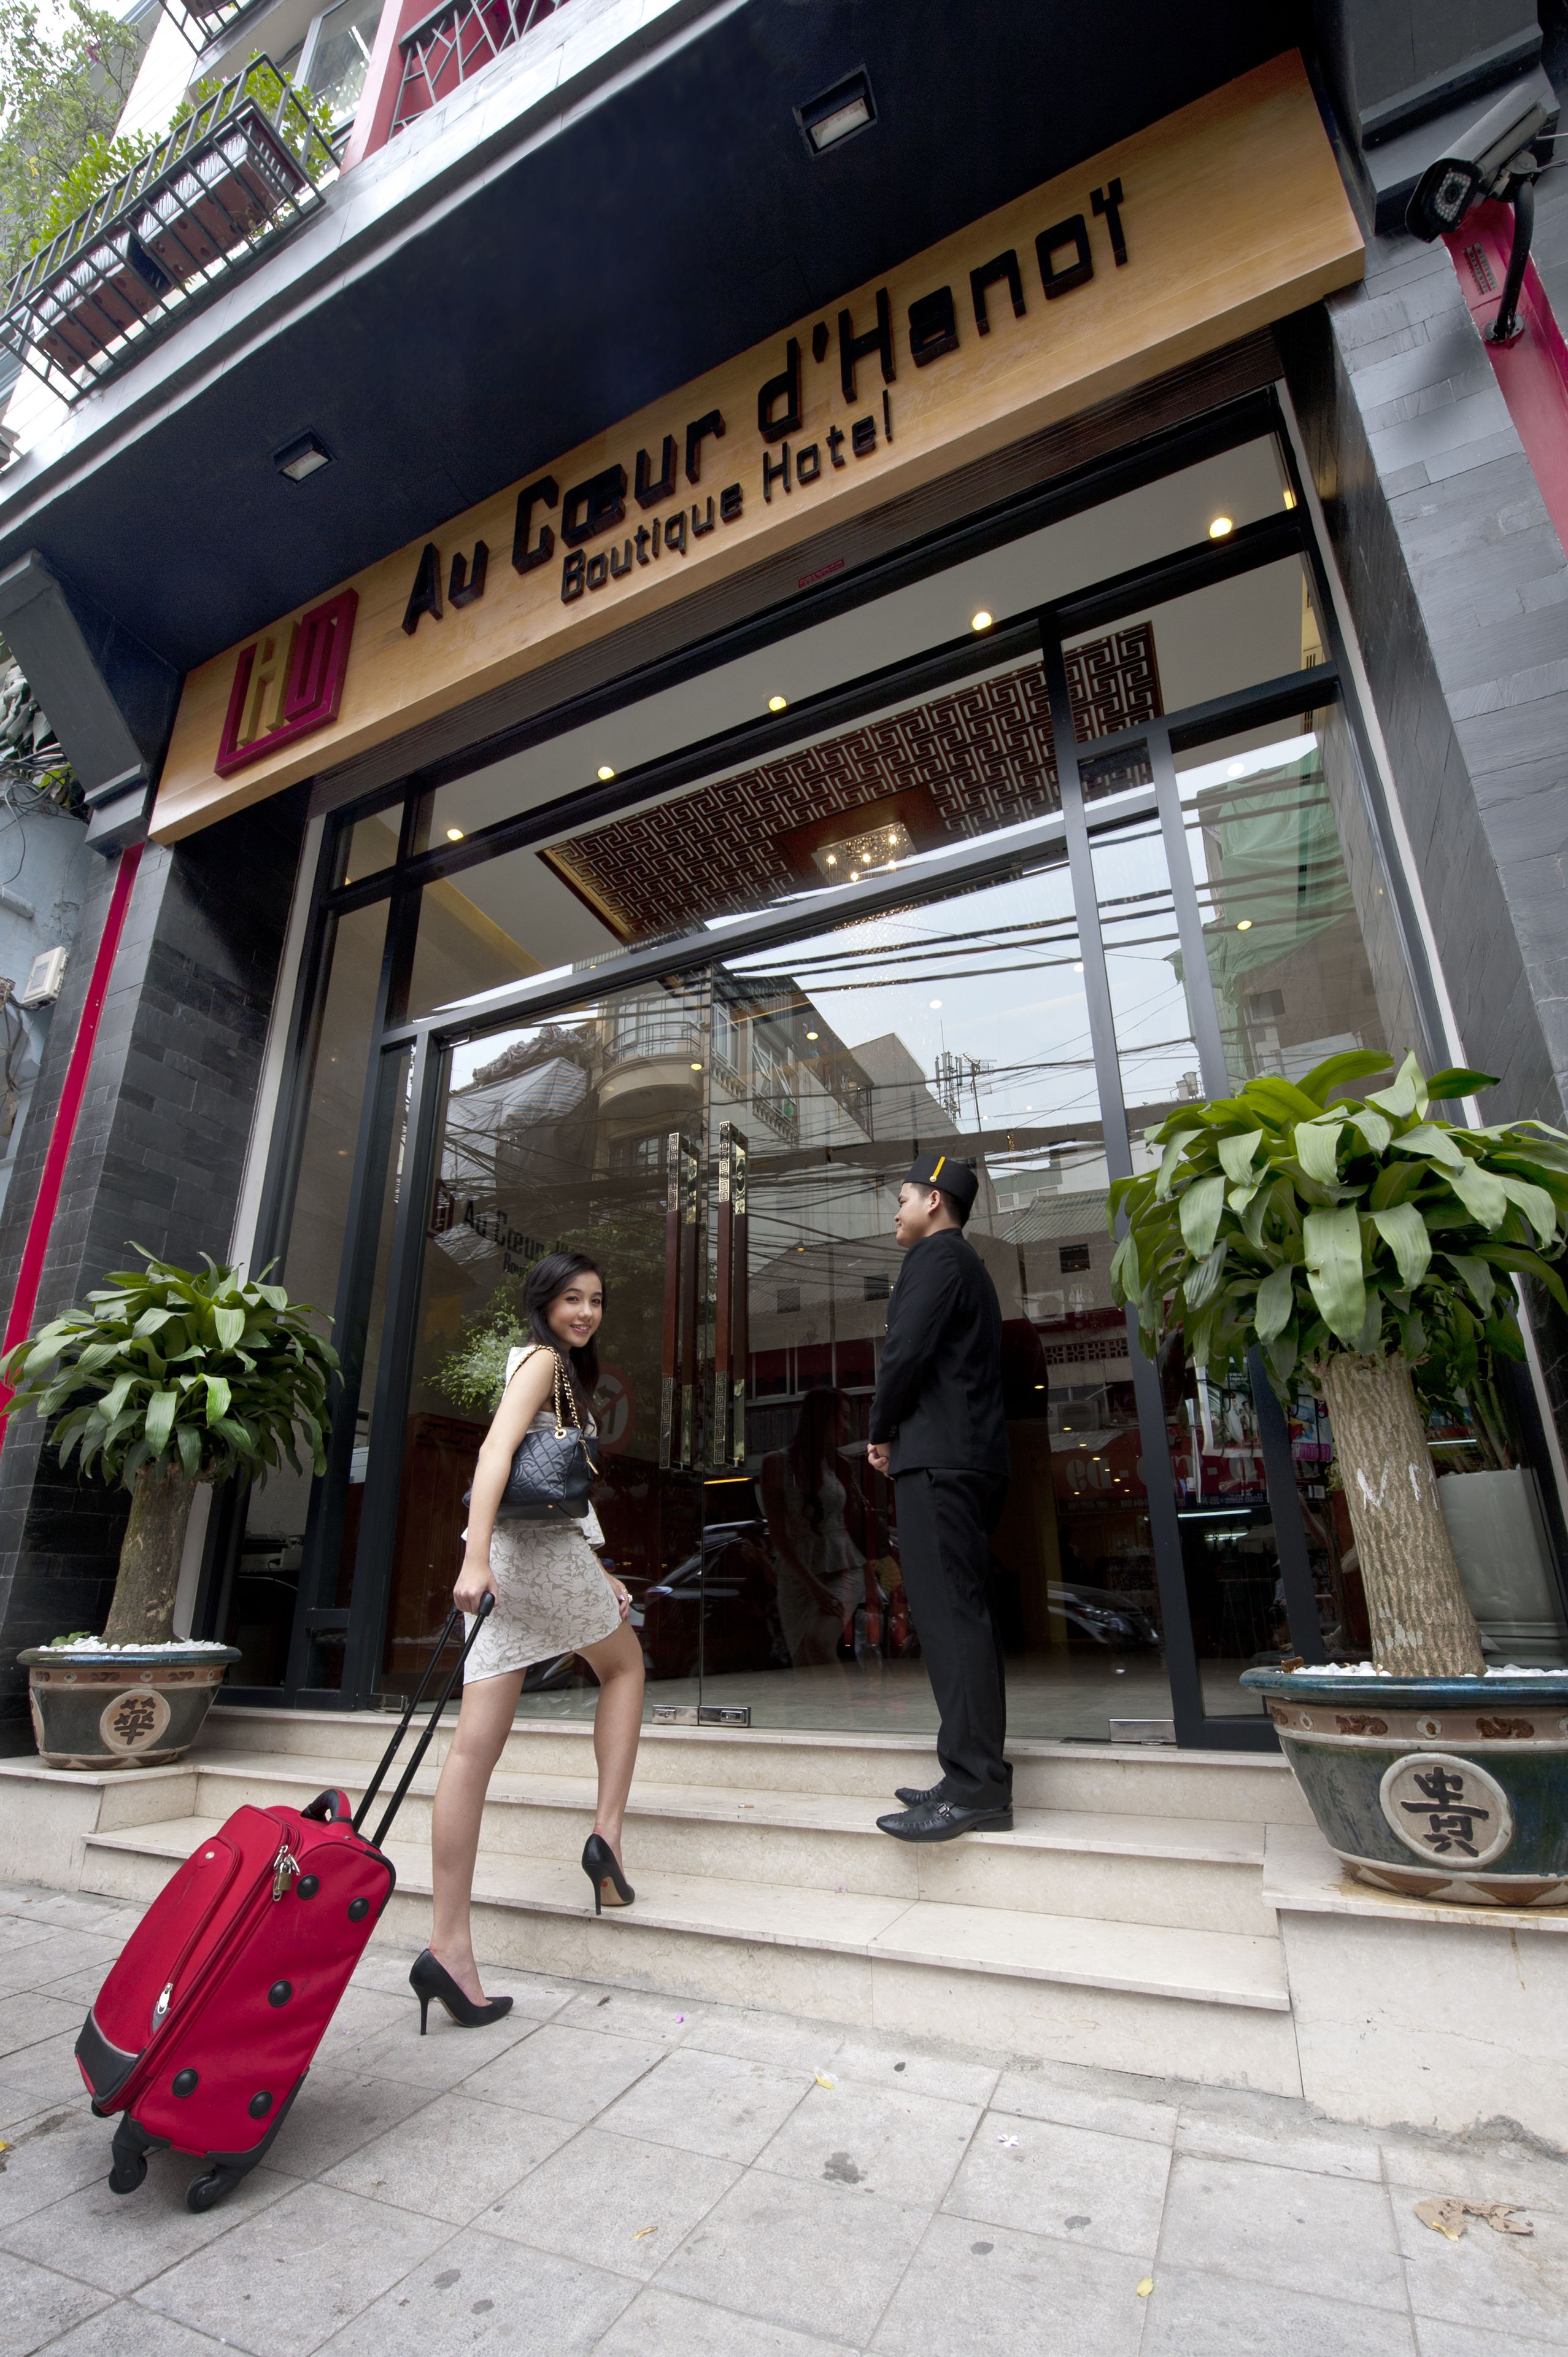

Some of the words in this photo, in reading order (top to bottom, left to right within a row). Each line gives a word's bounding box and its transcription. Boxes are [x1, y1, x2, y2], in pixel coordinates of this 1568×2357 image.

[402, 540, 489, 635] Au
[511, 409, 727, 575] Cœur
[560, 482, 743, 605] Boutique
[763, 389, 893, 503] Hotel
